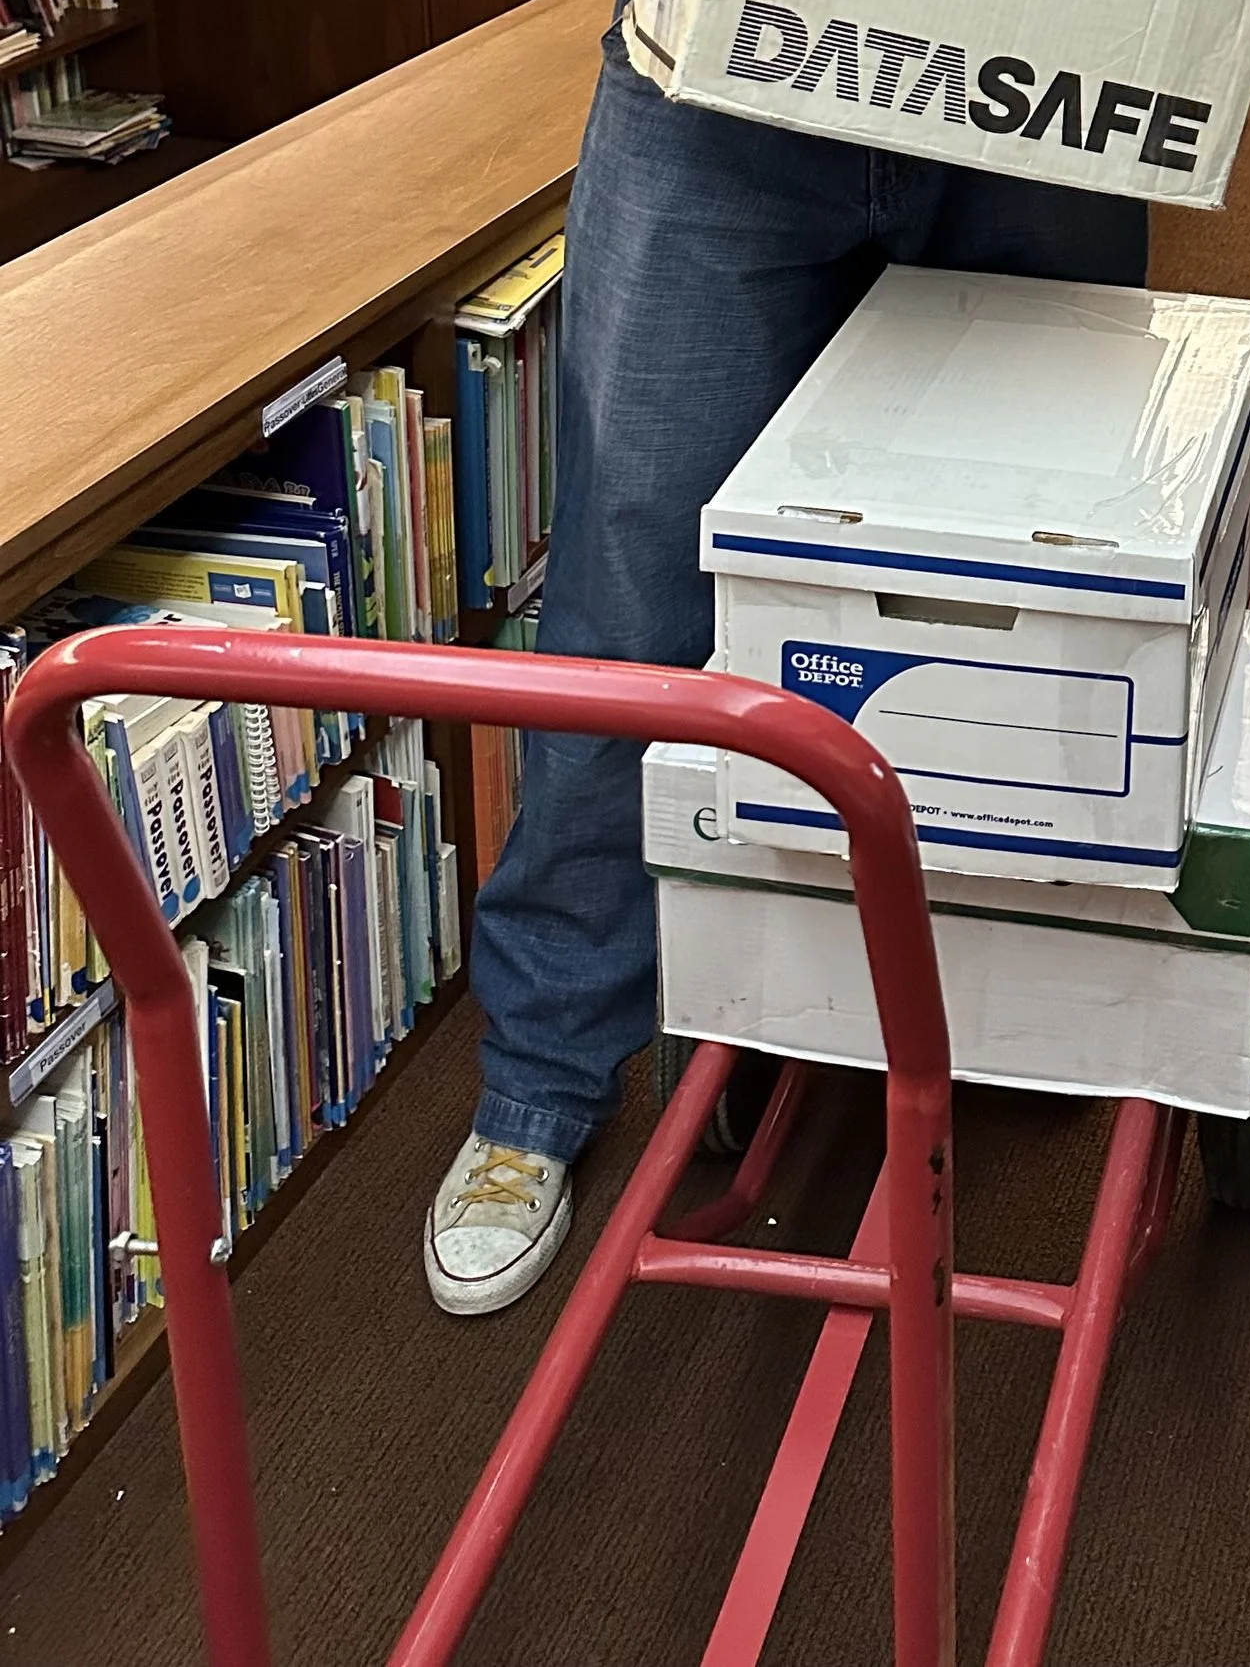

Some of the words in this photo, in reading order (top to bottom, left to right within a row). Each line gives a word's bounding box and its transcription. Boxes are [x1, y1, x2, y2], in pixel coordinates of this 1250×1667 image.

[726, 0, 1212, 173] DATASAFE
[790, 652, 864, 676] Office
[798, 670, 863, 688] DEPOT
[170, 778, 196, 880] Passover
[950, 810, 1054, 829] www.officedepot.com
[40, 1022, 86, 1072] Passover
